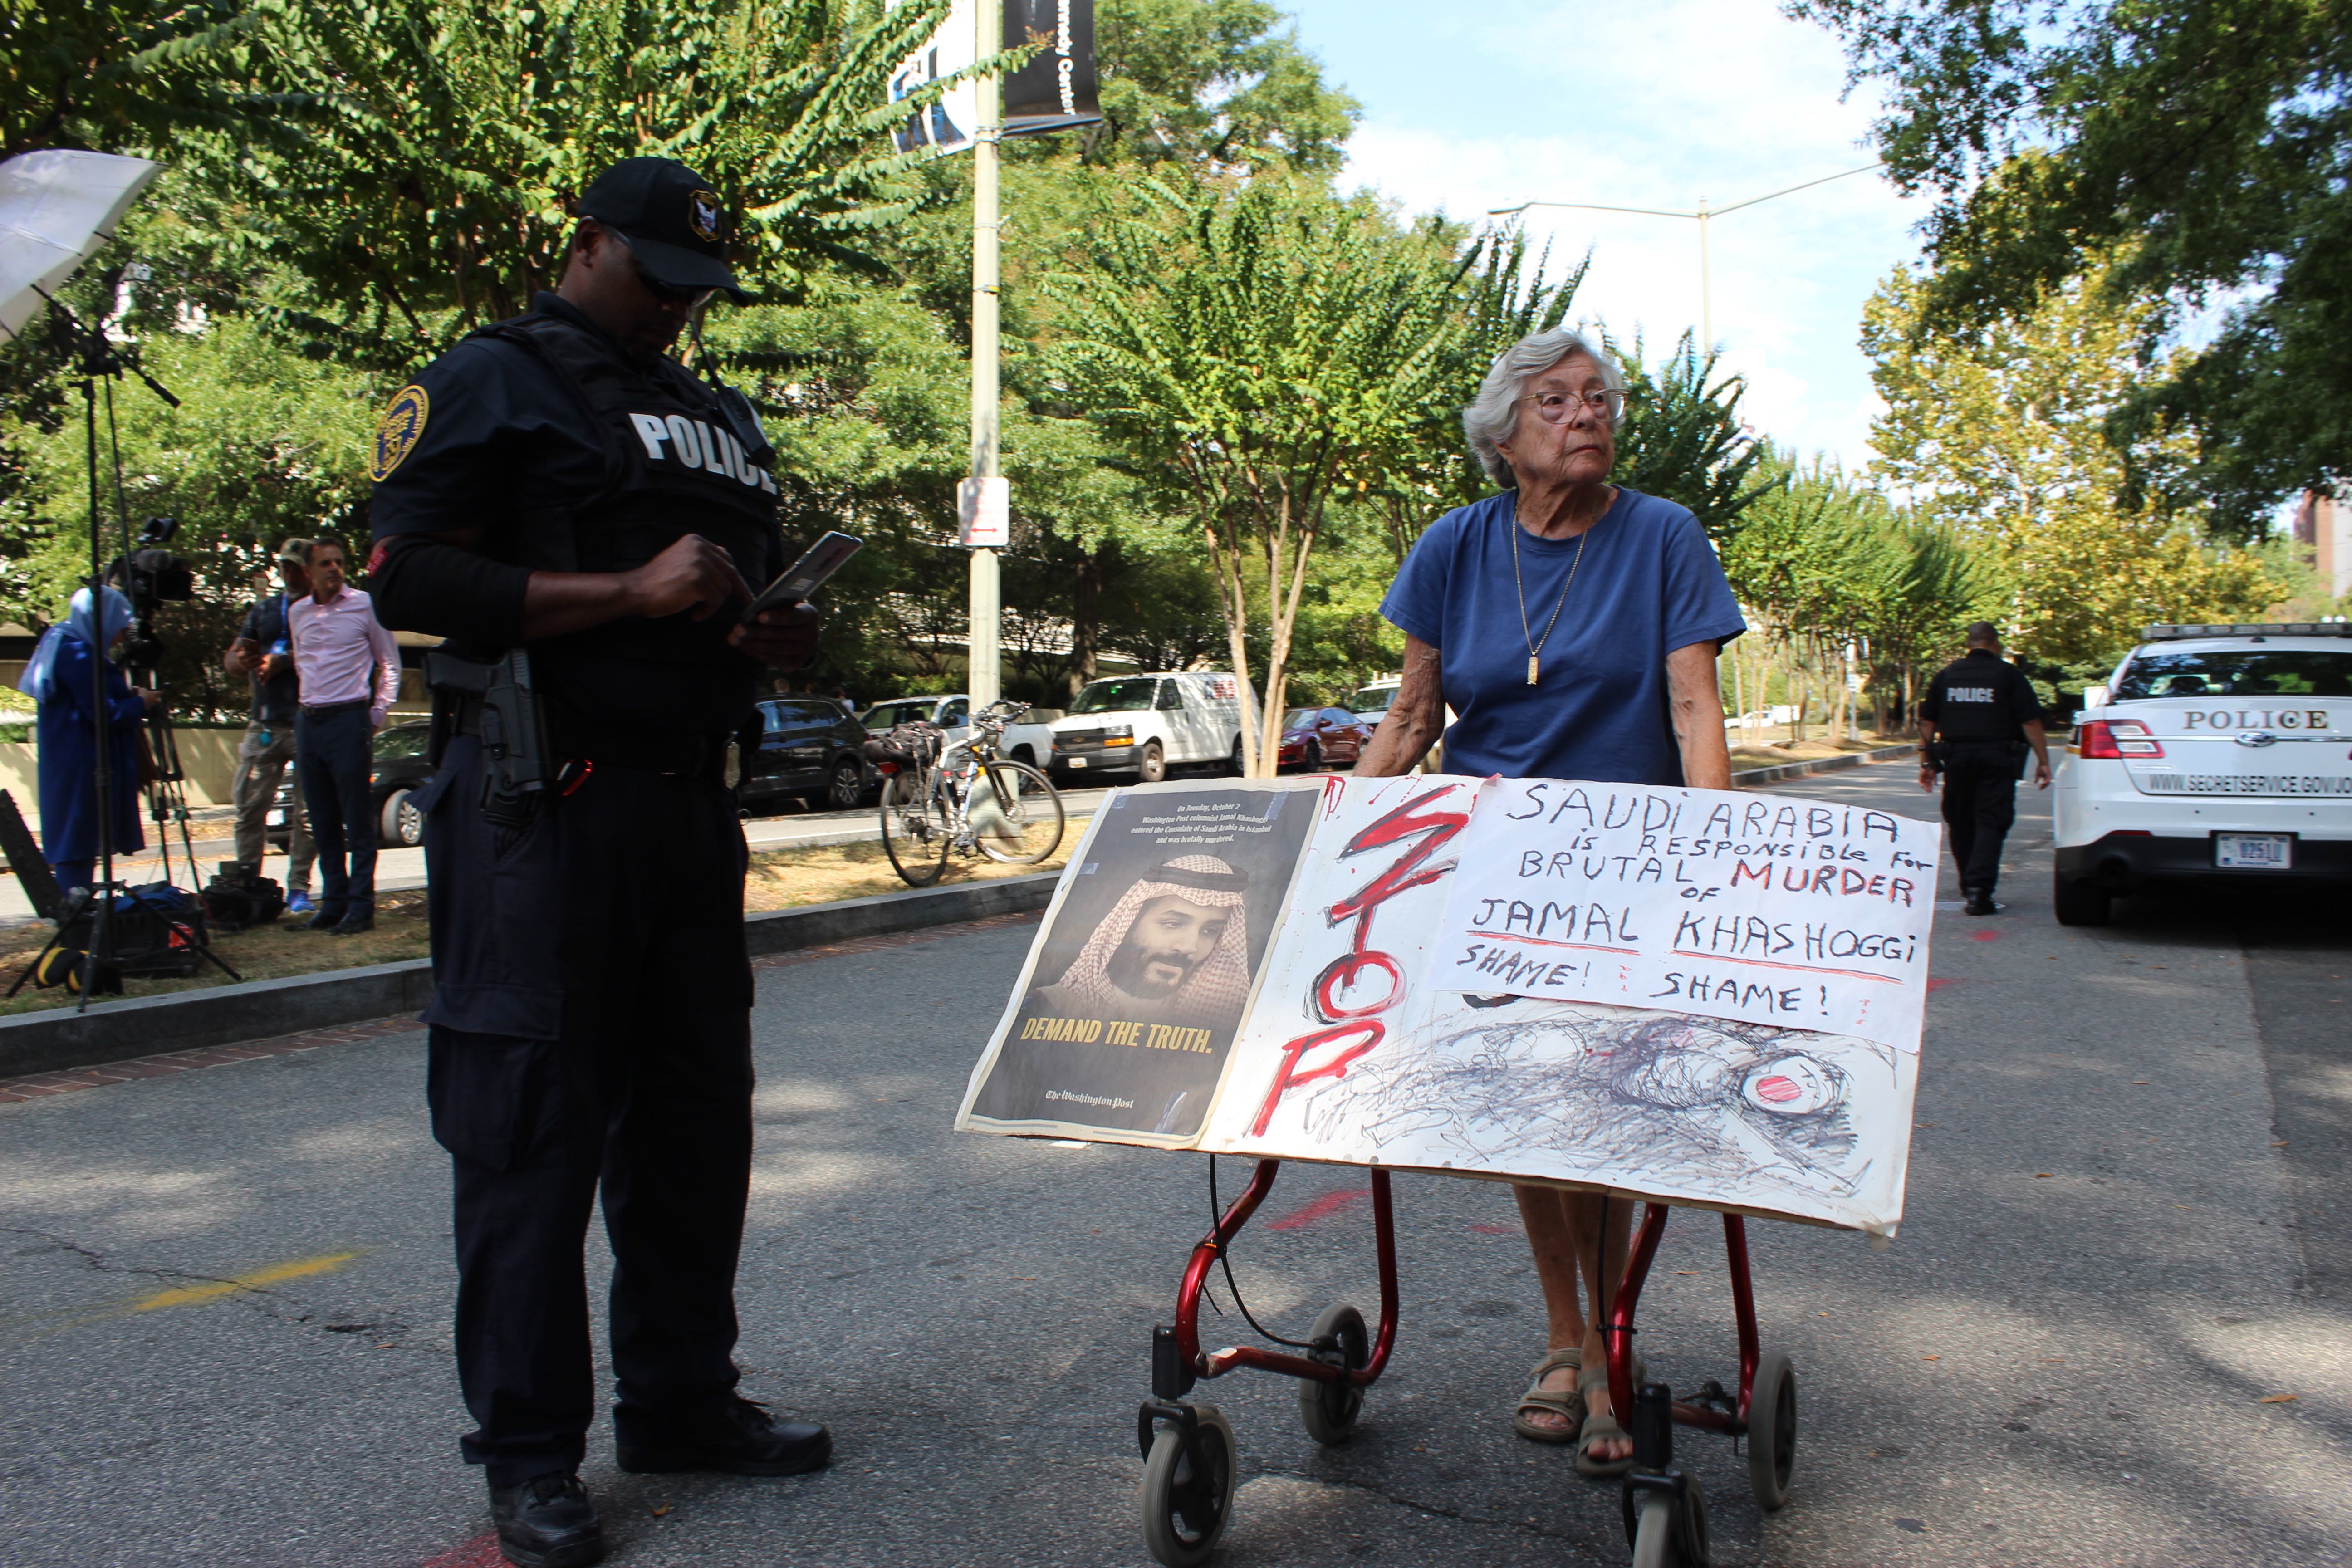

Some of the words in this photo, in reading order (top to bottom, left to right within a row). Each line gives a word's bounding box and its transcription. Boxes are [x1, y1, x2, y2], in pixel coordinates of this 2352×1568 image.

[1058, 58, 1076, 116] Center
[1947, 687, 1994, 702] POLICE
[2182, 710, 2328, 729] POLICE
[1186, 804, 1210, 812] Tuesday,
[1211, 803, 1235, 811] October
[1142, 816, 1176, 824] Washington
[1189, 814, 1219, 822] columnist
[1219, 813, 1236, 822] Jamal
[1236, 814, 1269, 824] Khashoggi
[1164, 825, 1193, 833] Consulate
[1218, 823, 1238, 832] Arabia
[1246, 825, 1272, 833] Istanbul
[1180, 836, 1205, 844] brutally
[1205, 834, 1234, 843] murdered.
[1519, 850, 1694, 883] BRUTAL
[1729, 858, 1916, 908] MURDER
[1472, 898, 1639, 943] JAMAL
[1456, 944, 1590, 989] SHAME!
[1648, 972, 1828, 1016] SHAME!
[1020, 1017, 1102, 1043] DEMAND
[1105, 1021, 1144, 1047] THE
[1145, 1024, 1213, 1054] TRUTH.
[1045, 1090, 1061, 1101] The
[1061, 1089, 1112, 1106] Washington
[1112, 1097, 1134, 1109] Post
